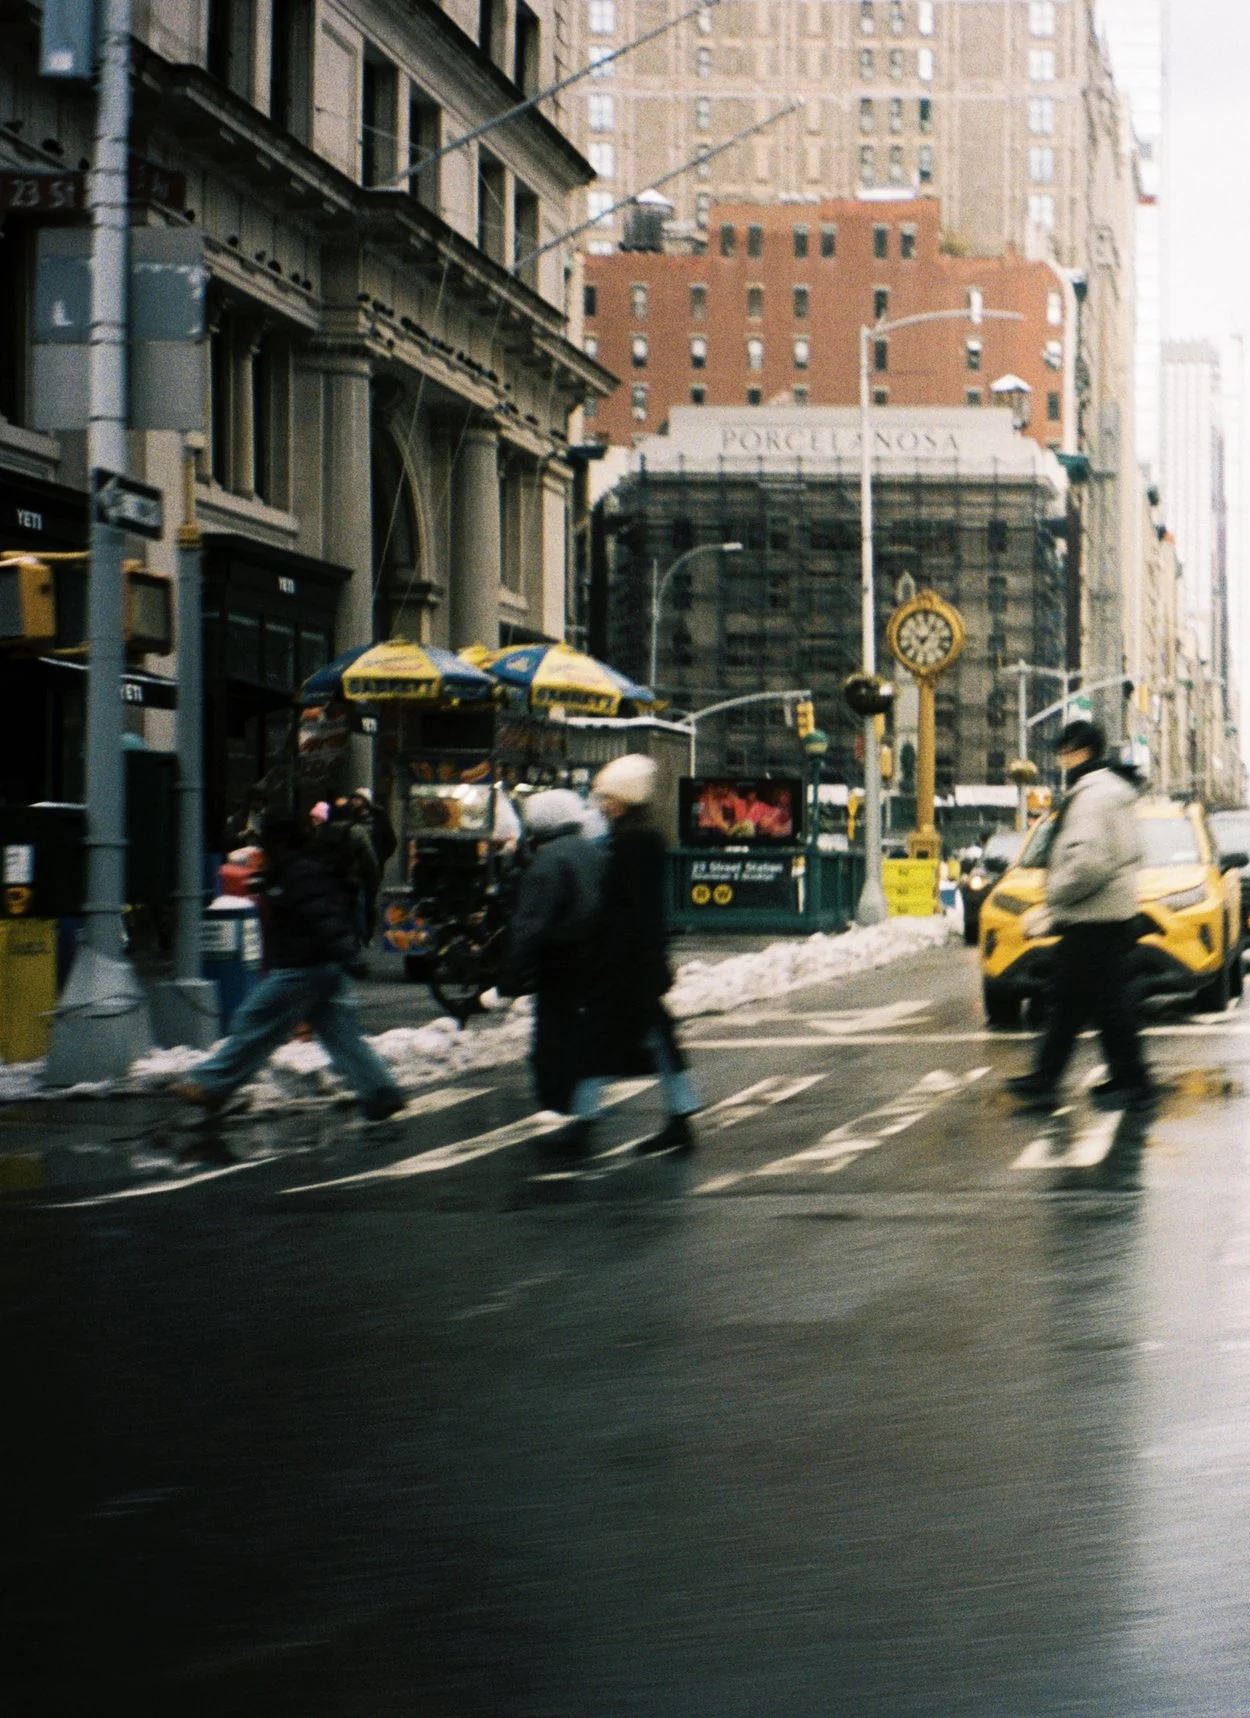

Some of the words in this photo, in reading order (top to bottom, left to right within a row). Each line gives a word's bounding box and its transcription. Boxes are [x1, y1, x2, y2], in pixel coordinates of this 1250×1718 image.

[11, 179, 40, 207] 23
[50, 180, 76, 207] St
[721, 428, 960, 450] PORCELANOSA
[16, 508, 43, 531] YETI
[279, 576, 294, 594] YETI
[709, 861, 741, 872] Street
[744, 861, 783, 873] Station
